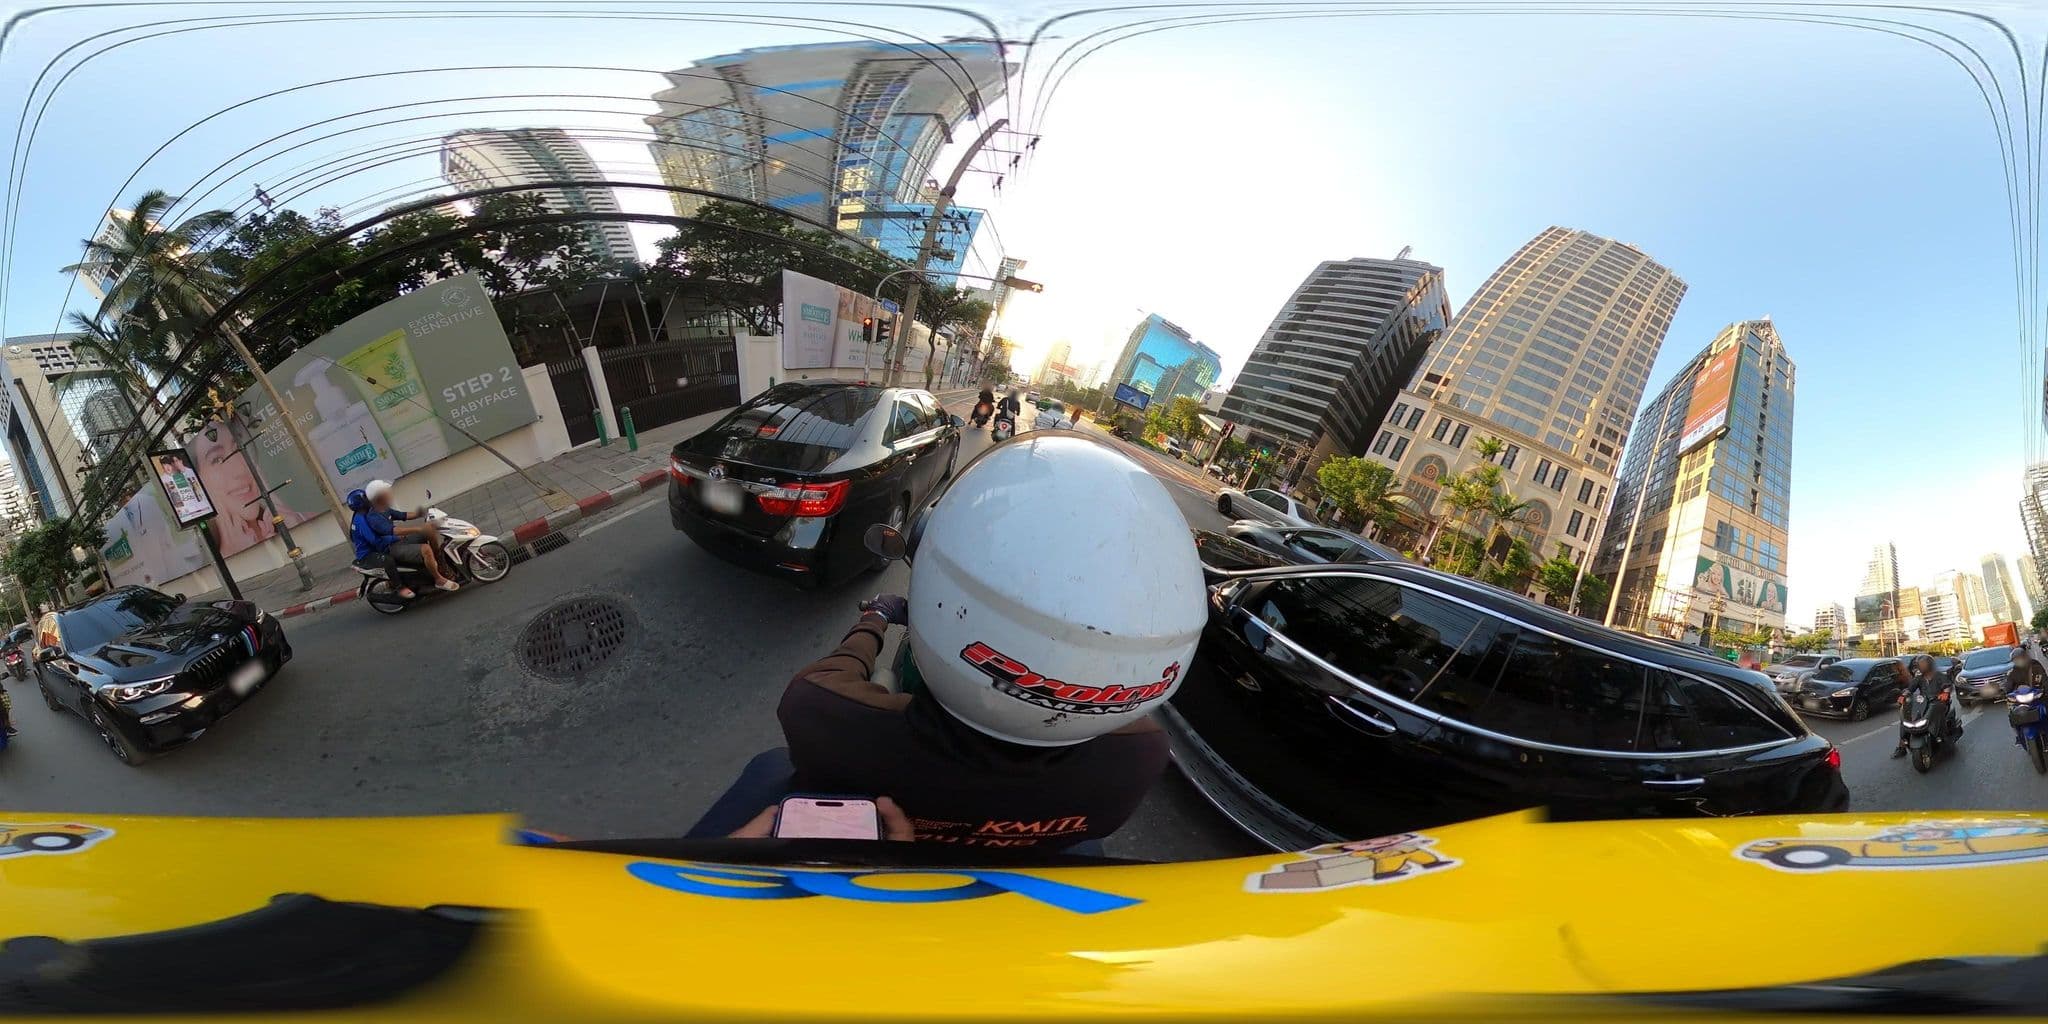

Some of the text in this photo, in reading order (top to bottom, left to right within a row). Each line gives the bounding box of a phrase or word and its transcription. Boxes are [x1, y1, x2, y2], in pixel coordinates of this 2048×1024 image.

[408, 311, 443, 329] EXTRA
[413, 306, 484, 338] SENSITIVE
[443, 366, 513, 403] STEP 2
[285, 389, 295, 401] 1
[451, 386, 518, 419] BABYFACE
[456, 414, 481, 430] GEL
[267, 438, 293, 457] WATE
[978, 816, 1088, 833] KMITL
